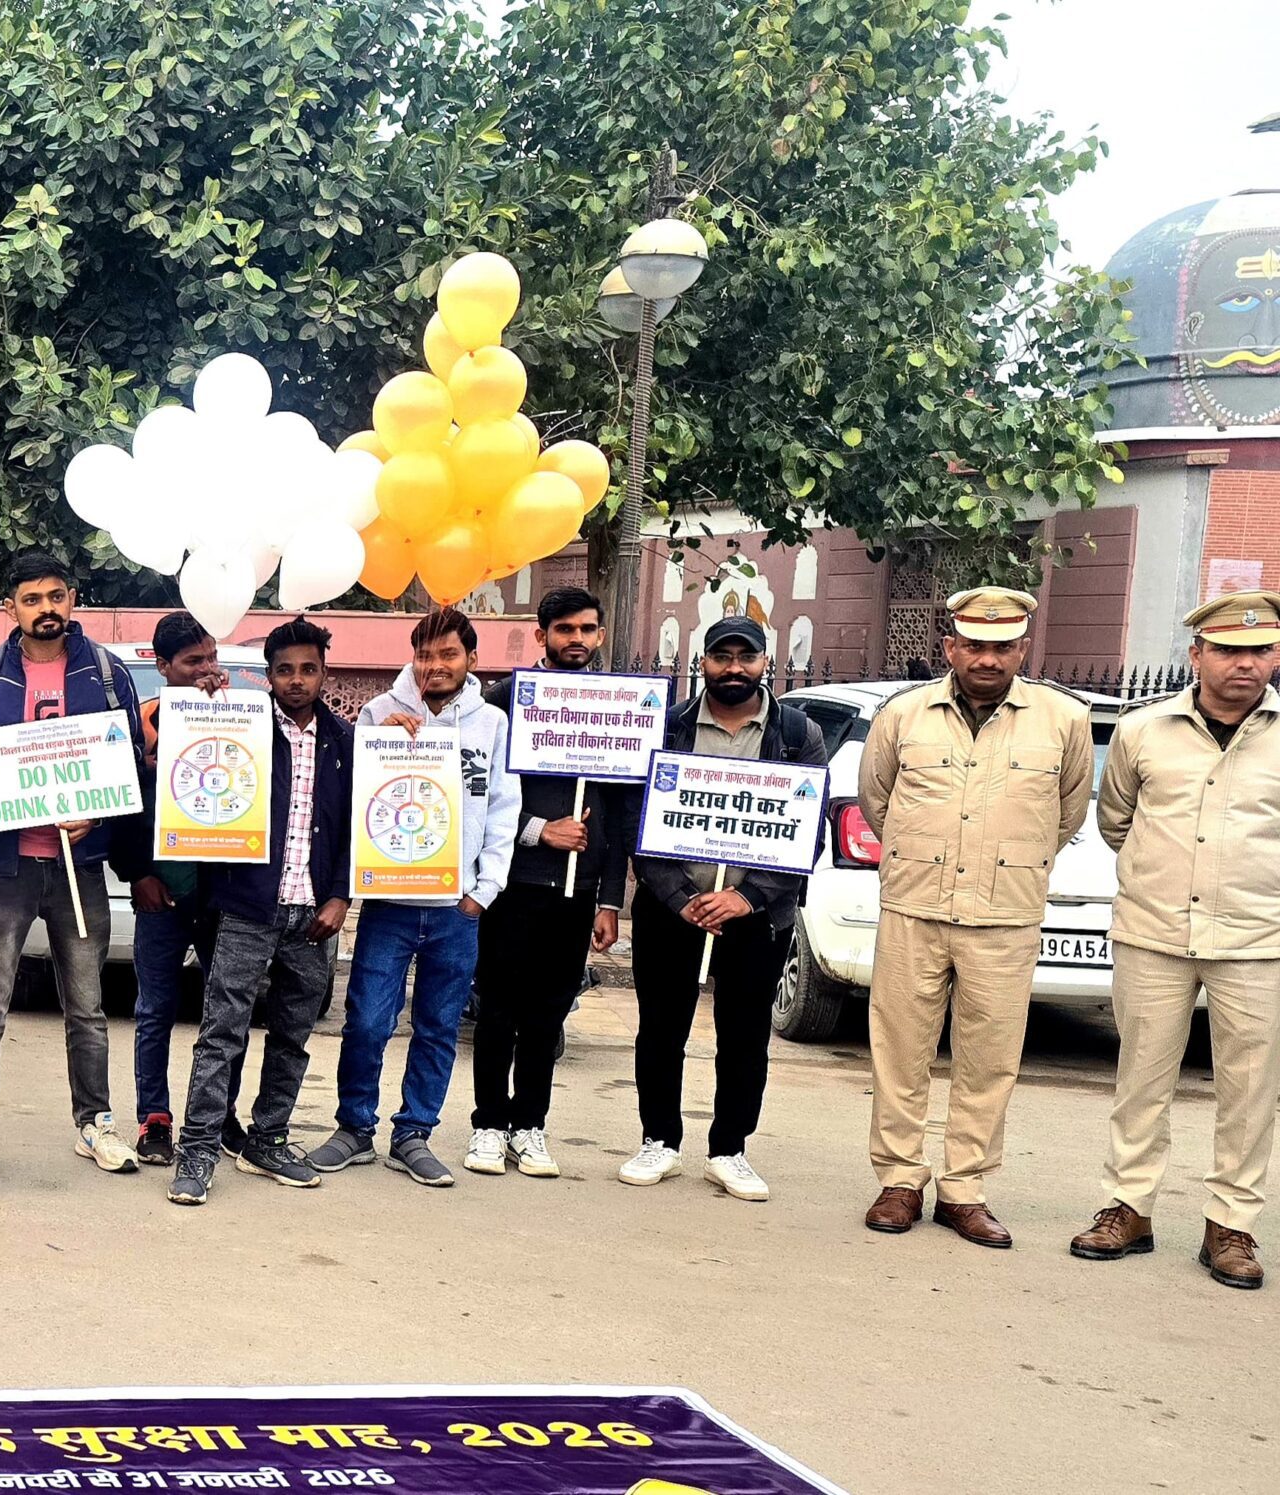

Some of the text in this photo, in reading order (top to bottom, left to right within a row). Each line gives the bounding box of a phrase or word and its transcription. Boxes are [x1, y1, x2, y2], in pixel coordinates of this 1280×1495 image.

[247, 704, 264, 713] 2026
[523, 706, 655, 729] परिवहन विभाग का एक ही नारा
[532, 730, 641, 751] सुरक्षित हो बीकानेर हमारा
[18, 759, 92, 789] DO NOT
[684, 767, 702, 782] सड़क
[703, 768, 722, 784] सुरक्षा
[762, 772, 792, 790] अभियान
[56, 792, 72, 815] &
[75, 784, 136, 813] DRIVE
[679, 789, 788, 816] शराब पी कर
[662, 810, 801, 841] वाहन ना चलायें
[32, 1425, 247, 1463] सुरक्षा
[257, 1424, 432, 1454] माह,
[447, 1421, 653, 1448] 2026
[82, 1468, 120, 1488] से
[126, 1471, 169, 1488] 31
[167, 1467, 291, 1488] जनवरी
[301, 1468, 396, 1487] 2026
